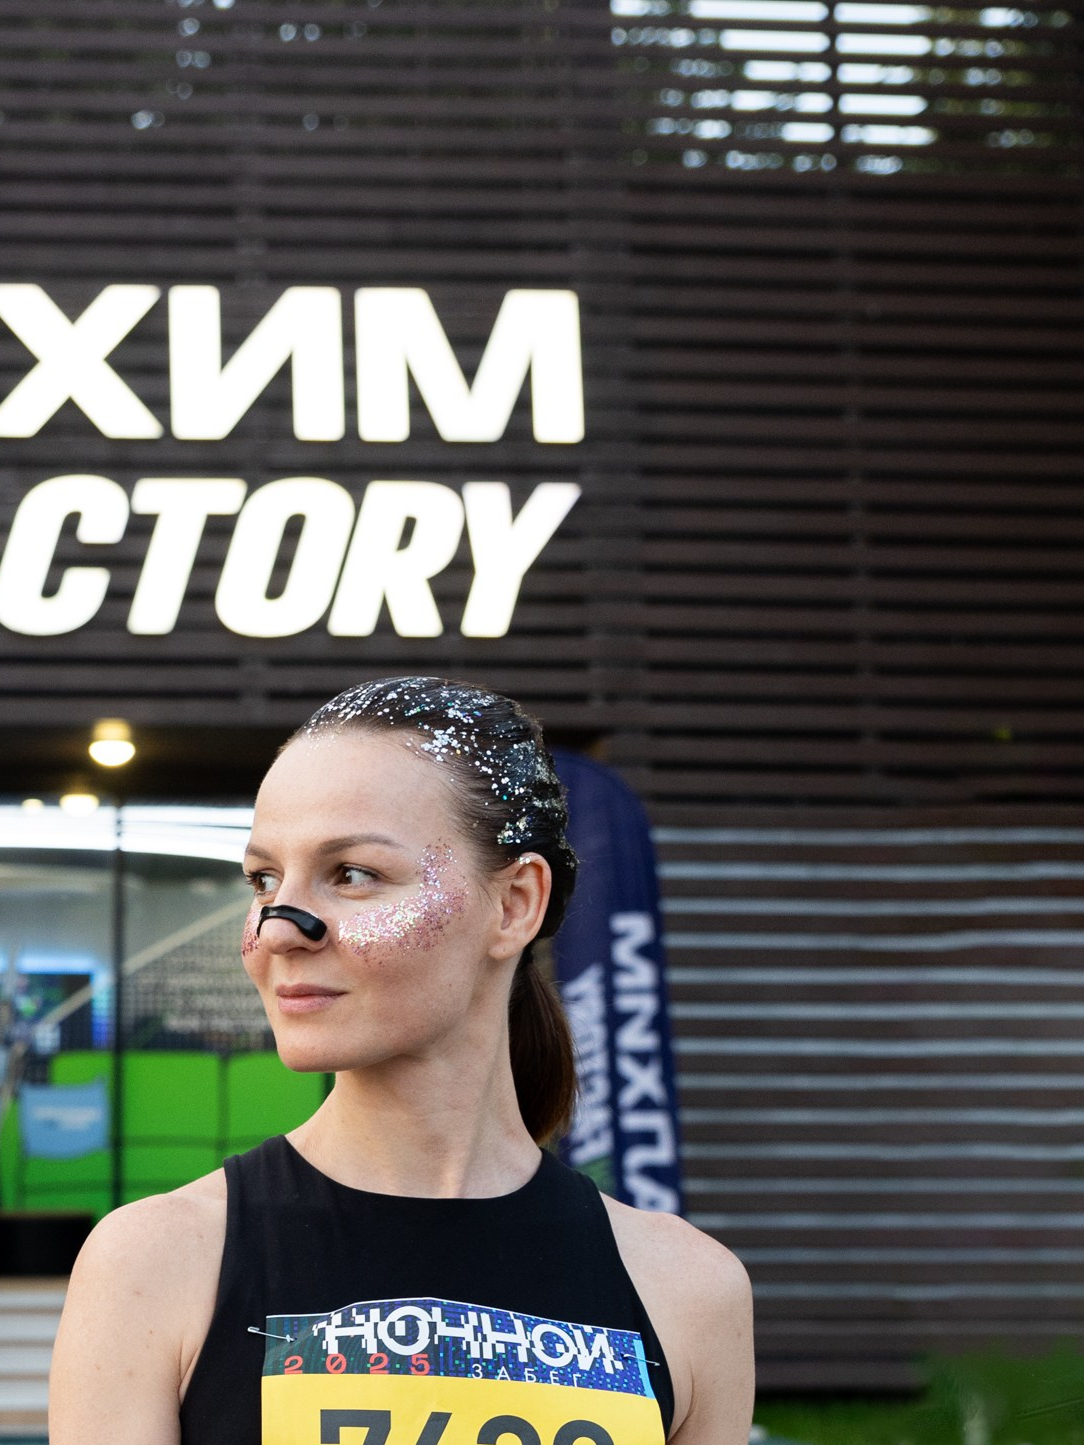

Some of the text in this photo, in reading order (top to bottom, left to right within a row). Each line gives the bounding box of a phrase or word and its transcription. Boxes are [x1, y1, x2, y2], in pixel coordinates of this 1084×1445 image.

[312, 1305, 624, 1375] НОЧНОЙ
[284, 1352, 431, 1375] 2025
[471, 1363, 582, 1388] ЗАБЕГ
